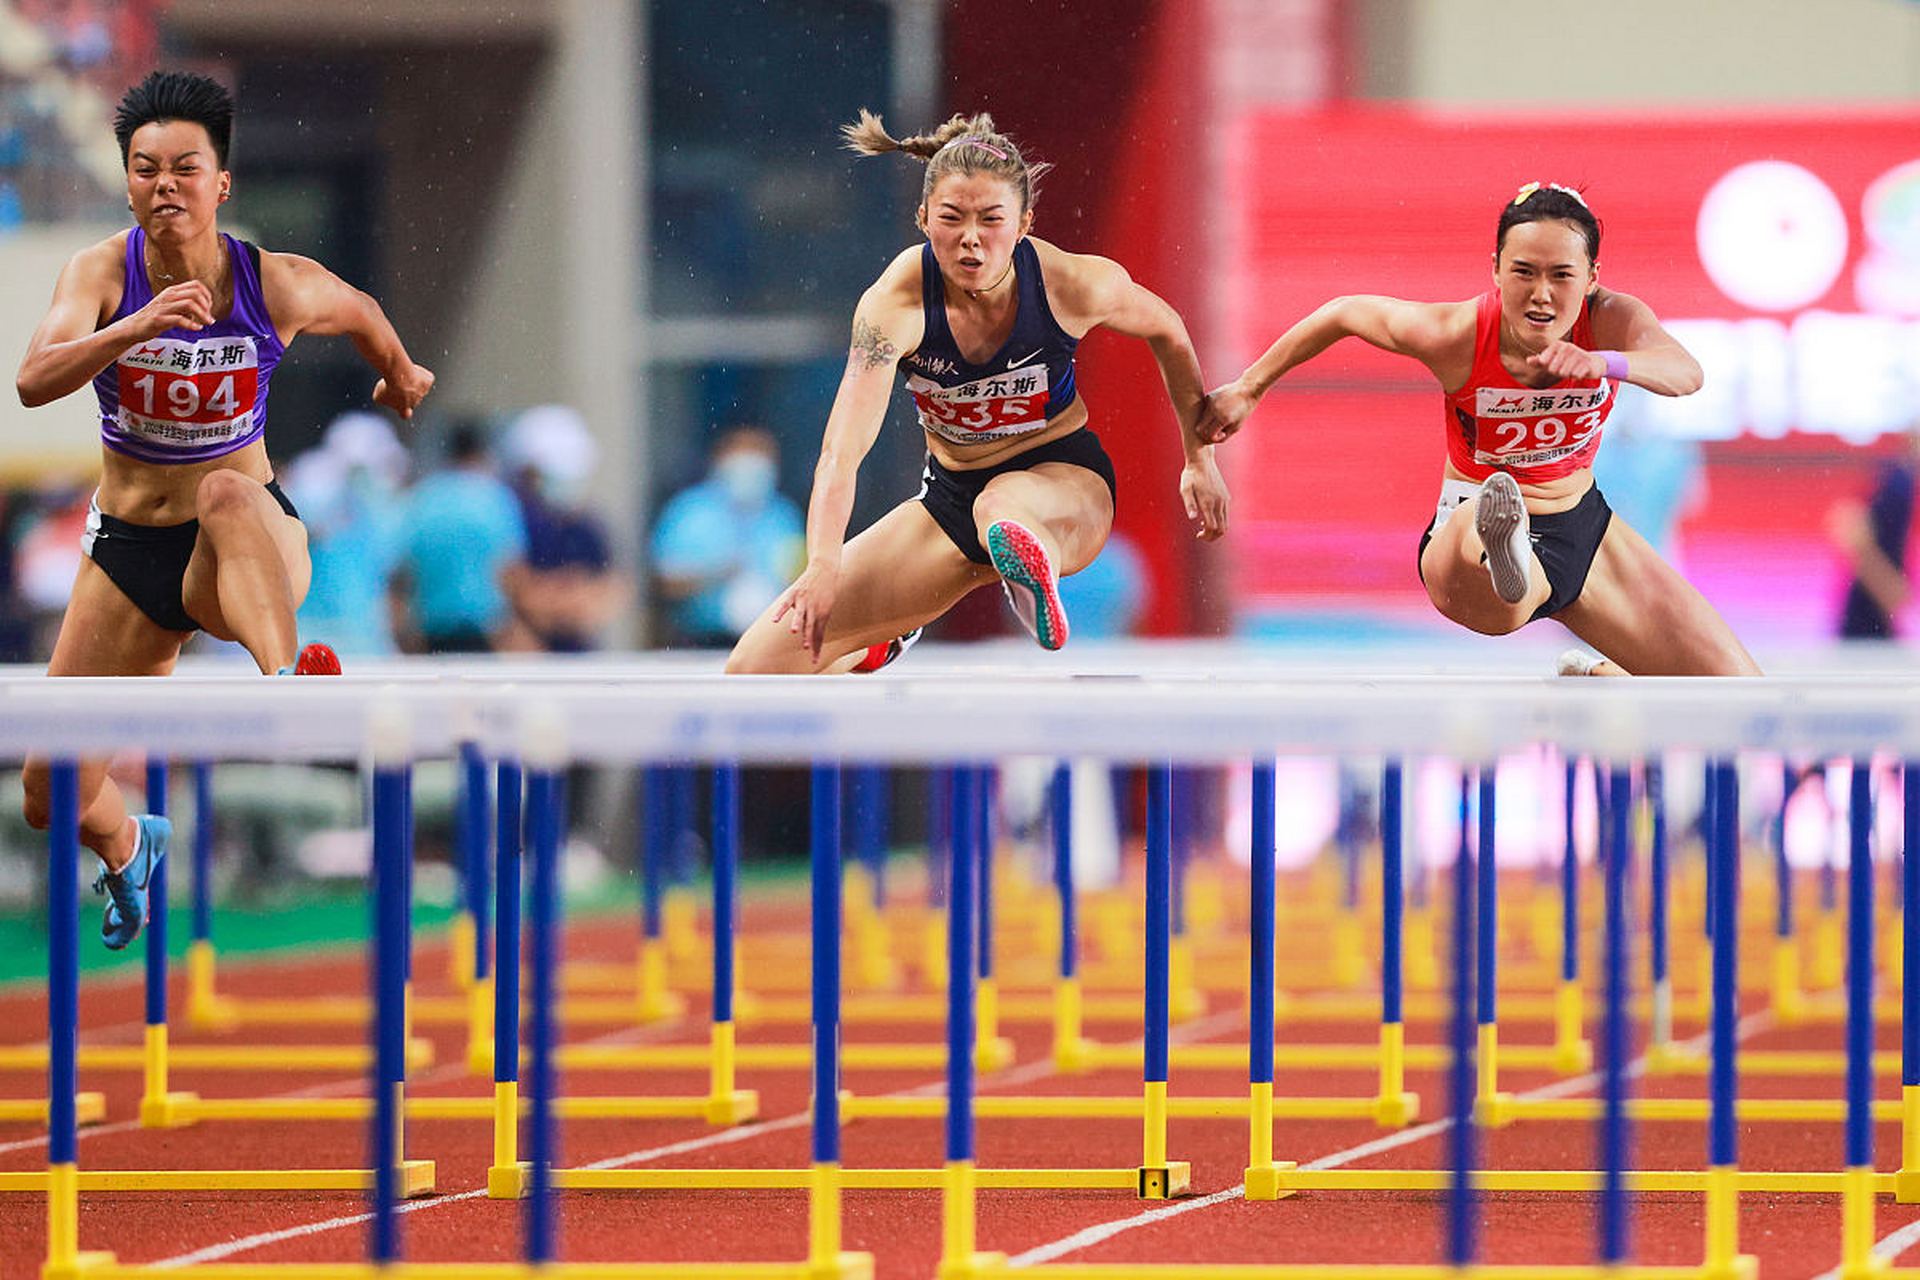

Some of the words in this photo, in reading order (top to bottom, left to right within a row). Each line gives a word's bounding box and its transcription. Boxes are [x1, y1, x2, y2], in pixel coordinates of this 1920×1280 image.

[127, 356, 163, 366] HEALTH
[170, 345, 245, 370] 海尔斯
[134, 374, 240, 417] 194
[1495, 411, 1601, 453] 293
